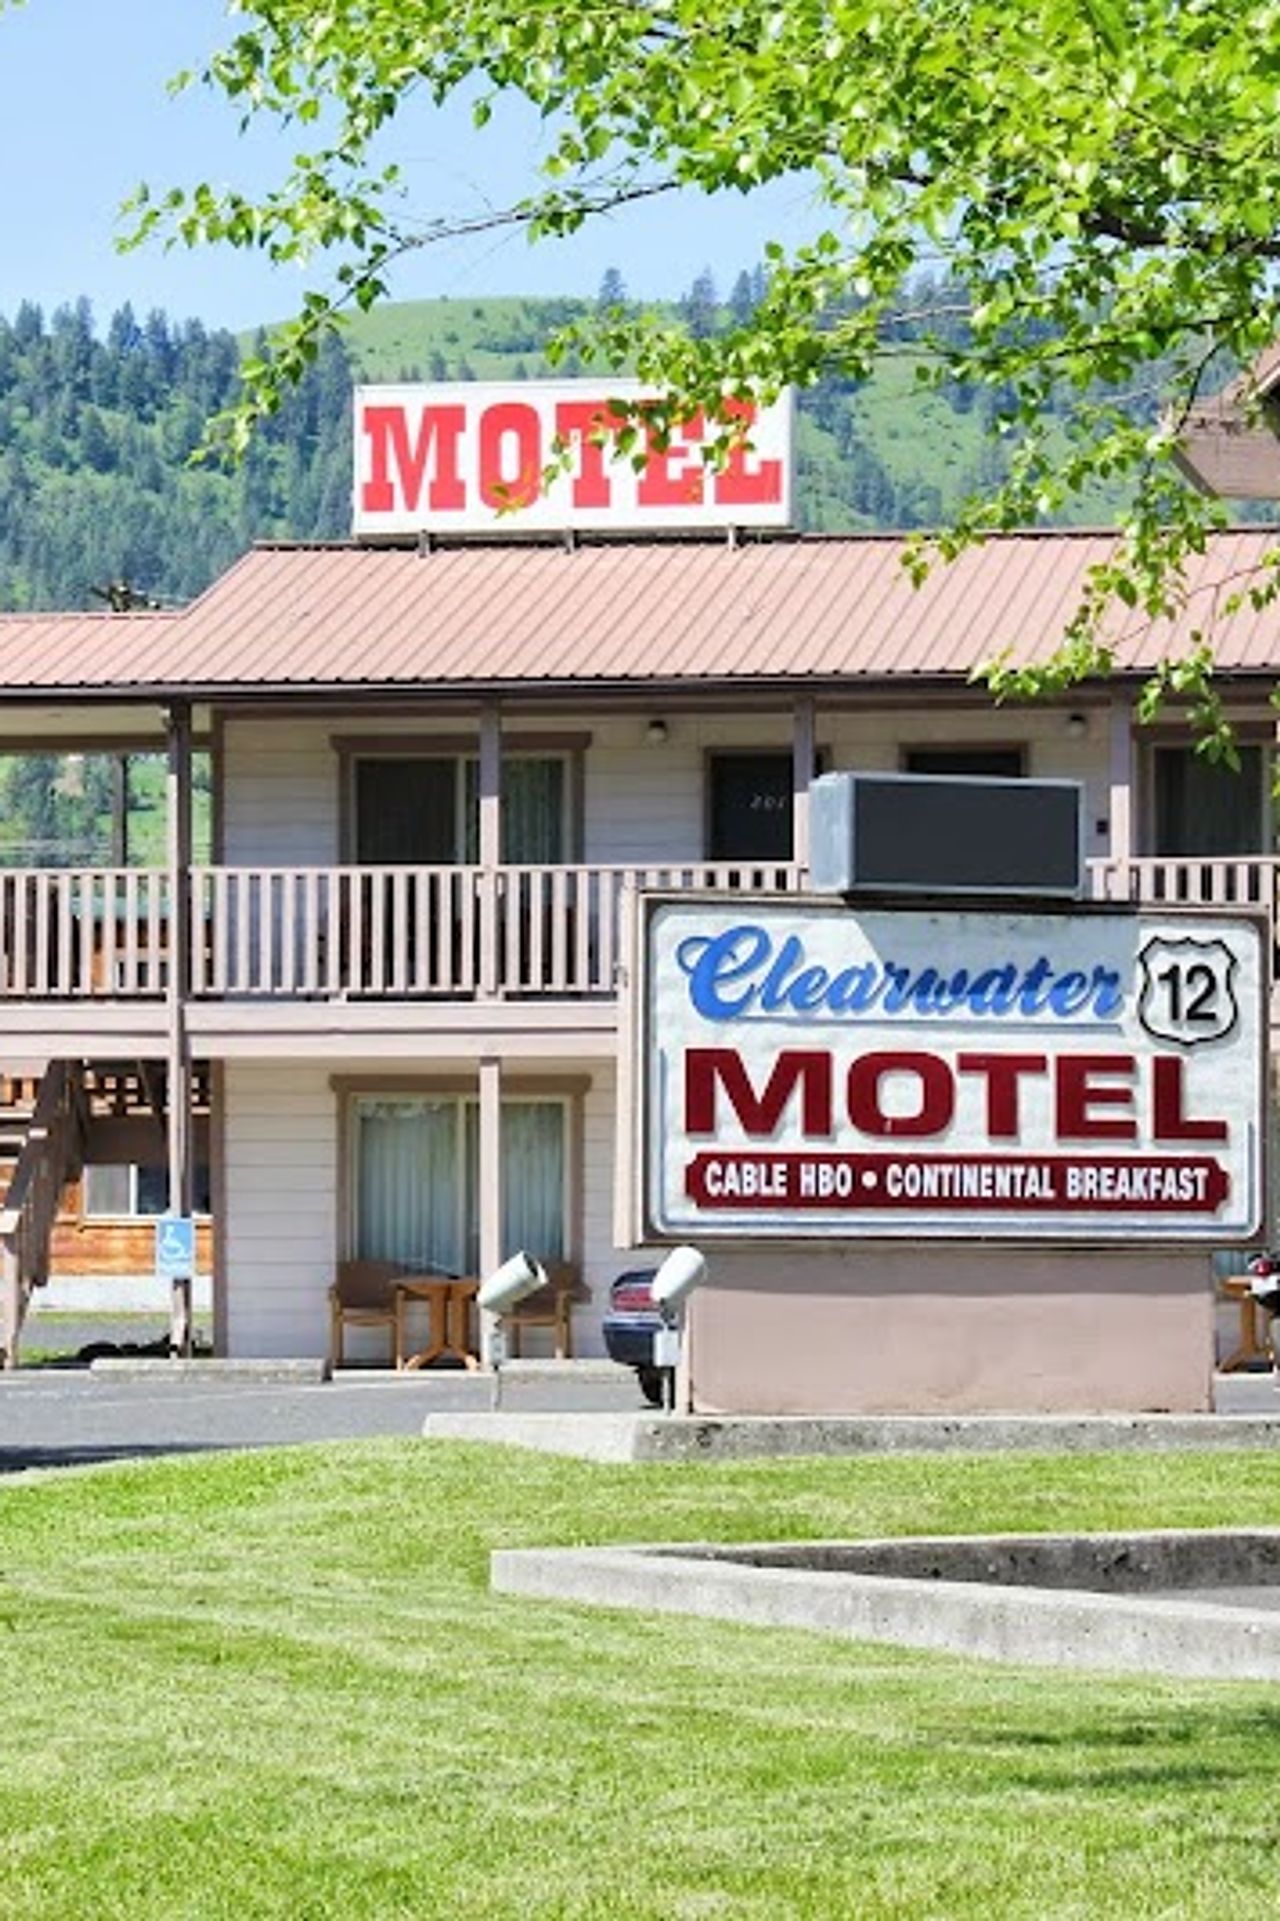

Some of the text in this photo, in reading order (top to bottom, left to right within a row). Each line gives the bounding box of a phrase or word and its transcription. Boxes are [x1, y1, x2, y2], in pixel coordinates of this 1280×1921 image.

[362, 397, 783, 512] MOTEL
[676, 925, 1127, 1020] Clearwater
[1158, 963, 1219, 1023] 12
[684, 1048, 1229, 1141] MOTEL
[705, 1161, 1210, 1201] CABLE HBO CONTINENTAL BREAKFAST
